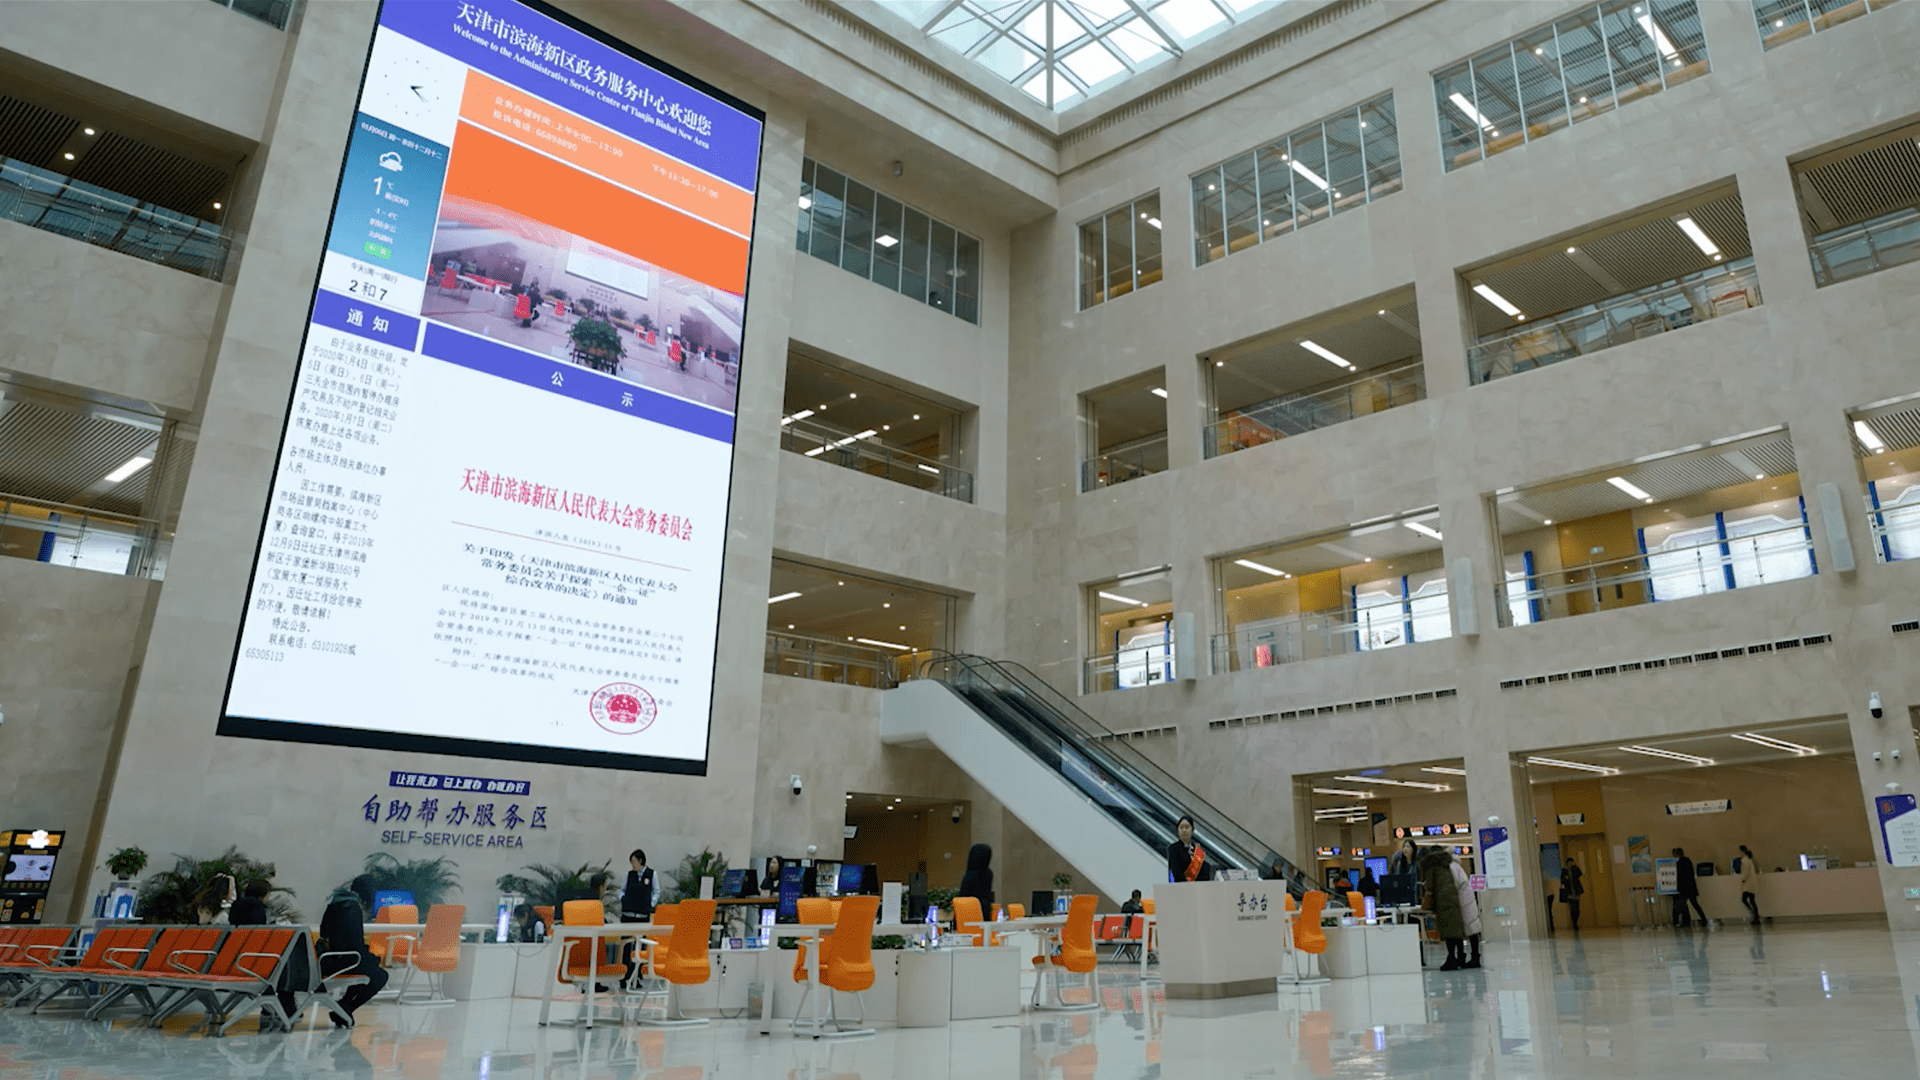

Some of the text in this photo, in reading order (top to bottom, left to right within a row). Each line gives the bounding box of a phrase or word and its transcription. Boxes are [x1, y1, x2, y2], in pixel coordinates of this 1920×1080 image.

[454, 0, 712, 137] 天津市滨海新区政务服务中心欢迎您
[452, 22, 709, 149] Welcome to the Administrative Service Centre of Tianjin Binhai New Area
[370, 174, 383, 195] 1
[348, 278, 388, 302] 2 和 7
[346, 307, 389, 334] 通知
[309, 434, 343, 452] 特此公告
[459, 465, 693, 542] 天津市滨海新区人民代表大会常务委员会
[362, 794, 548, 830] 自助帮办服务区
[381, 829, 523, 848] SELF-SERVICE AREA
